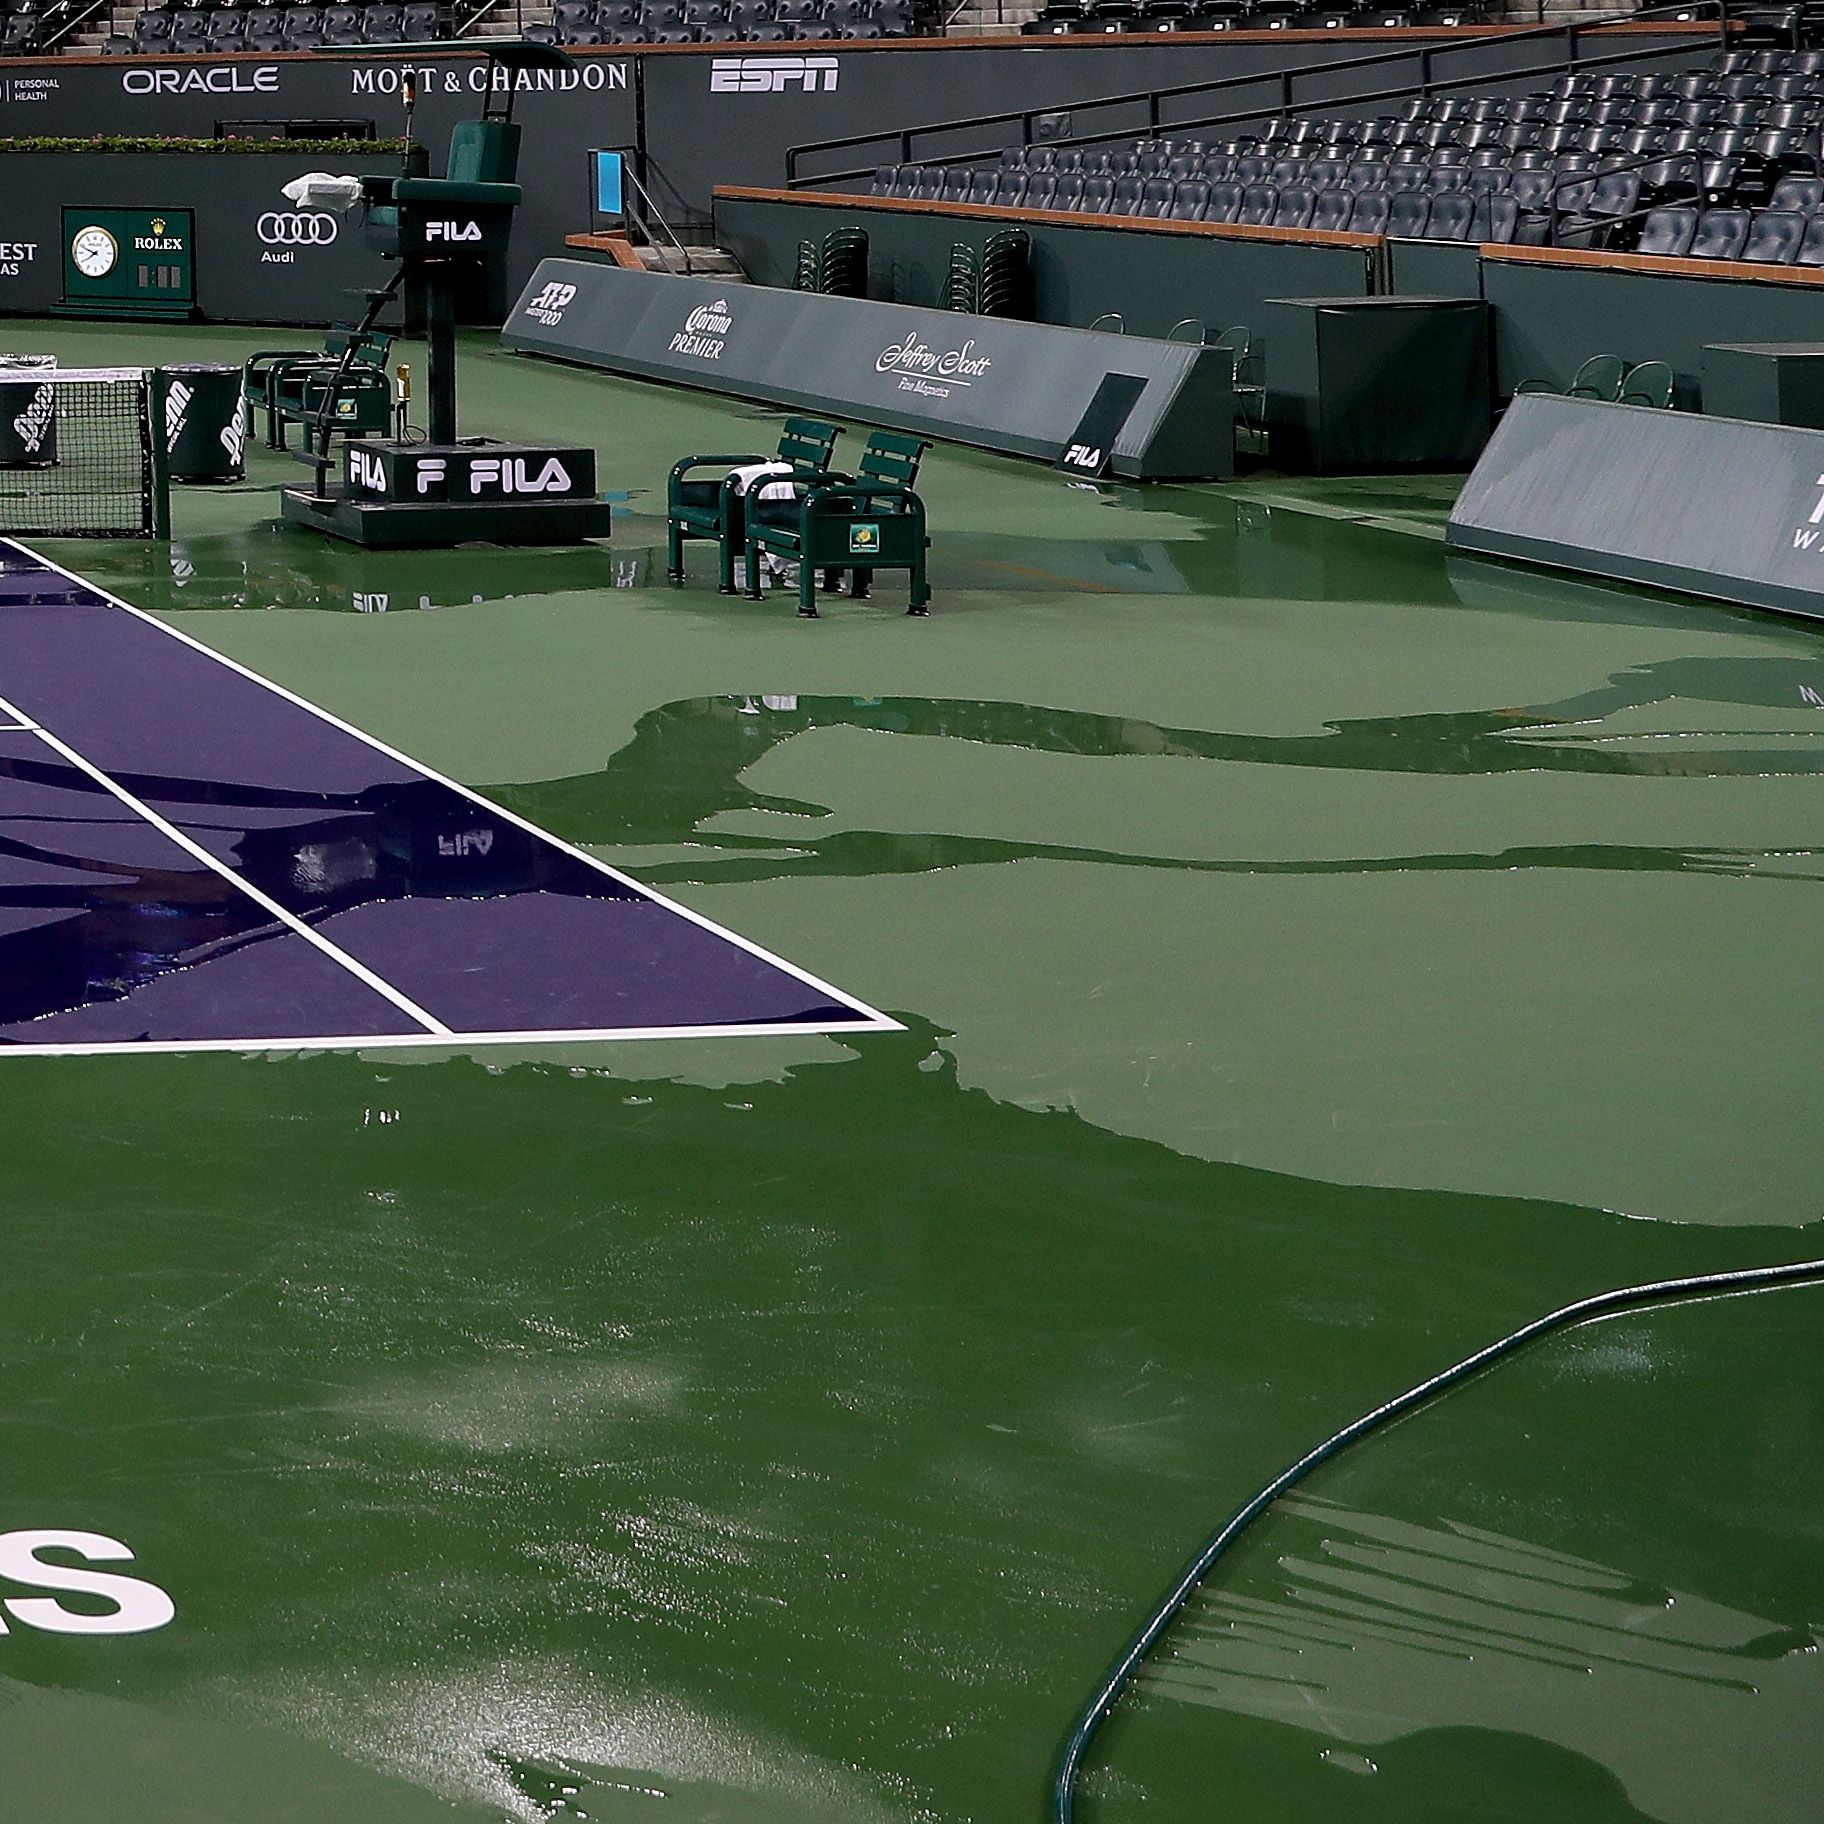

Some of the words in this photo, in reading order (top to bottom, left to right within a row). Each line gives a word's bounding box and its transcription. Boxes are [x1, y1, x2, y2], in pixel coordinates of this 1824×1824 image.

[14, 78, 59, 89] PERSONAL
[122, 66, 280, 94] ORACLE
[444, 72, 461, 93] &
[468, 61, 628, 93] CHANDON
[710, 57, 840, 92] ESPN
[14, 91, 48, 101] HEALTH
[135, 237, 183, 250] ROLEX
[426, 221, 482, 242] FILA
[261, 250, 294, 263] Audi
[530, 281, 578, 310] ATP
[538, 309, 563, 326] 1000
[685, 303, 733, 335] Corona
[667, 332, 725, 360] PREMIER
[875, 331, 941, 373] Jeffrey
[937, 339, 992, 376] Scott
[1064, 444, 1101, 468] FILA
[350, 449, 387, 493] FILA
[416, 459, 447, 494] F
[469, 457, 572, 494] FILA
